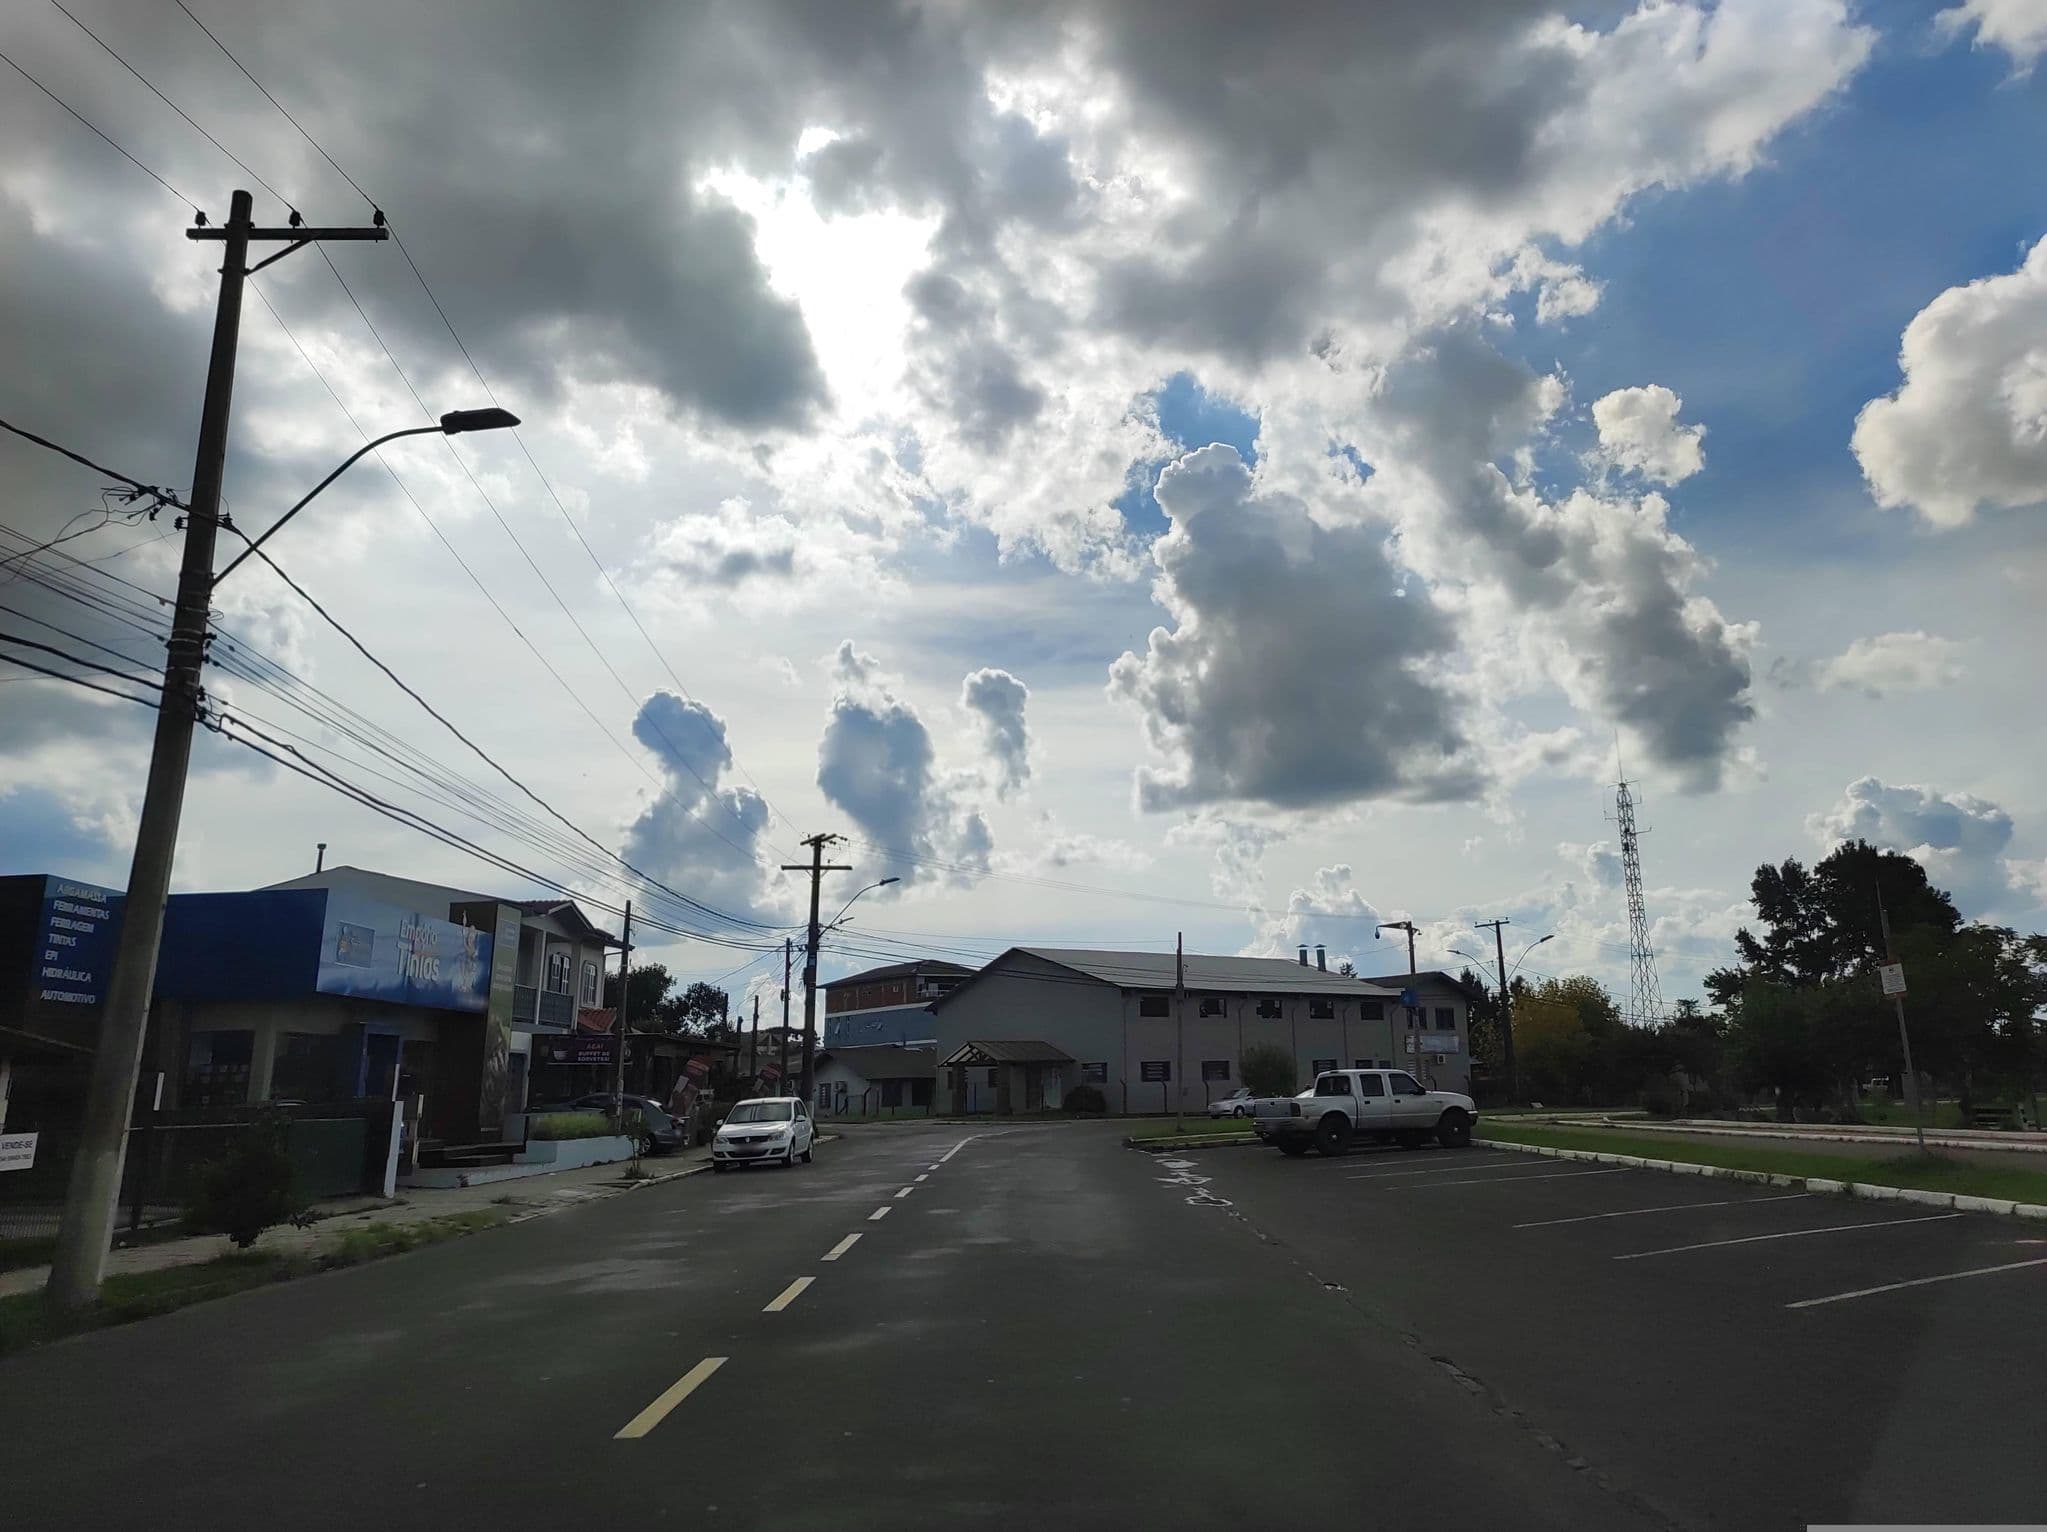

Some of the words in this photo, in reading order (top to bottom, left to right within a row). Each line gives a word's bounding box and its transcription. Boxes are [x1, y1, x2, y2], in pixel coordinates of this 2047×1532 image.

[53, 900, 111, 920] FERRAMENTAS
[51, 917, 95, 933] FERRAGEM
[48, 933, 77, 946] TINTAS
[45, 950, 58, 960] EPI
[397, 942, 440, 981] Tintas
[40, 989, 96, 1004] AUTOMOTIVO
